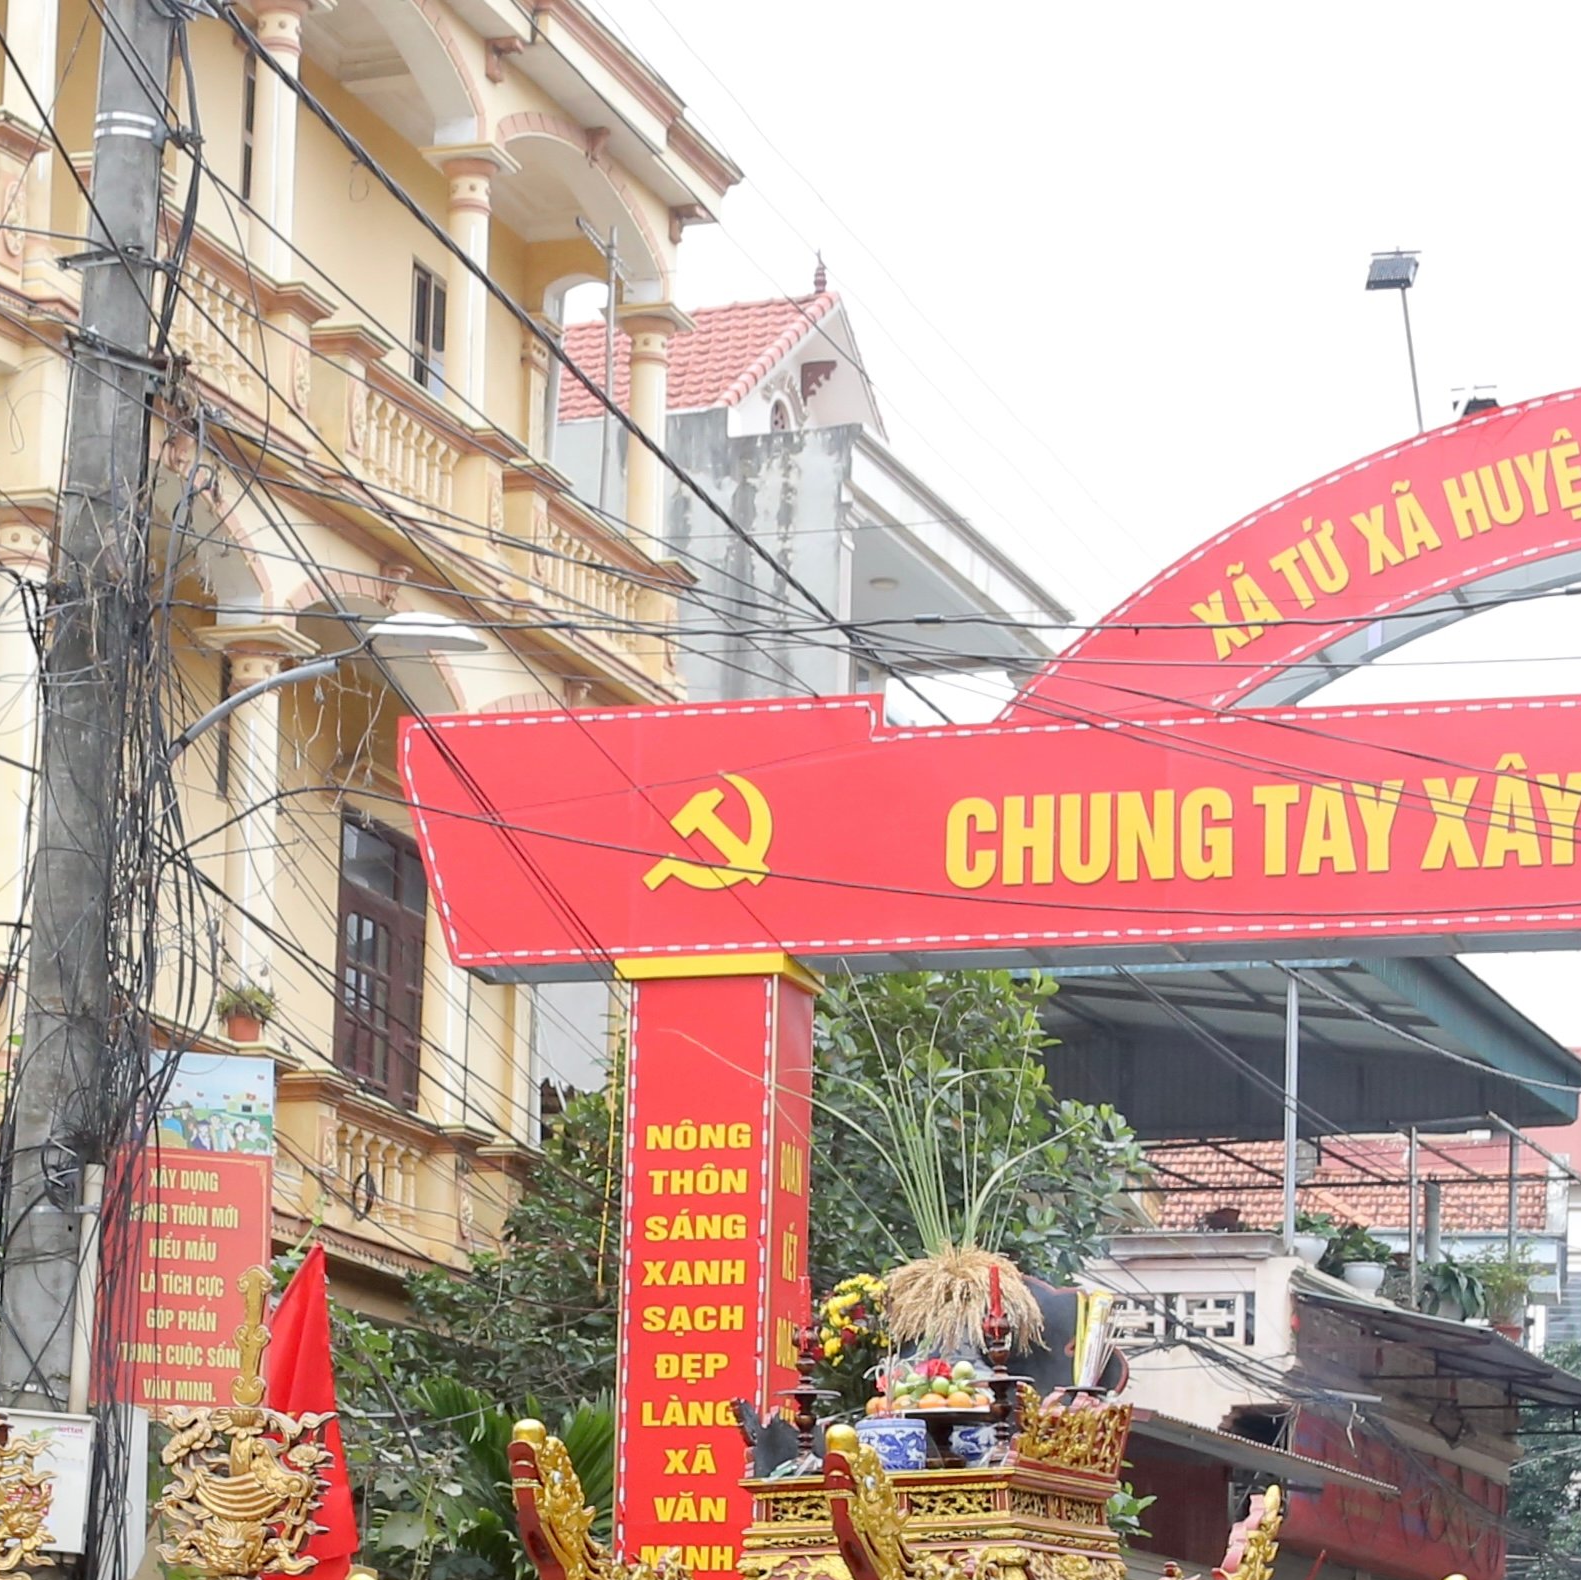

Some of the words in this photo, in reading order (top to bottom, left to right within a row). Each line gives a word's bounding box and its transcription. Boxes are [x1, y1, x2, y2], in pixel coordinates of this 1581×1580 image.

[1190, 561, 1285, 661] XÃ
[1269, 516, 1351, 611] TỨ
[1350, 480, 1443, 576] XÃ
[945, 787, 1235, 890] CHUNG
[1252, 780, 1405, 876] TAY
[645, 1119, 753, 1151] NÔNG
[149, 1165, 177, 1189] XÂY
[180, 1169, 219, 1195] DỰNG
[648, 1162, 749, 1196] THÔN
[171, 1201, 207, 1227] THÔN
[211, 1204, 239, 1228] MỚI
[644, 1208, 748, 1242] SÁNG
[148, 1231, 181, 1260] KIỂU
[184, 1234, 217, 1262] MẪU
[161, 1270, 192, 1295] TÍCH
[196, 1275, 225, 1301] CỰC
[641, 1257, 746, 1287] XANH
[146, 1305, 174, 1329] GÓP
[641, 1305, 745, 1338] SẠCH
[166, 1341, 203, 1371] CUỘC
[654, 1353, 729, 1384] ĐẸP
[175, 1379, 217, 1402] MINH.
[641, 1394, 739, 1428] LÀNG
[664, 1443, 717, 1476] XÃ
[653, 1491, 728, 1524] VĂN
[639, 1545, 734, 1571] MNH
